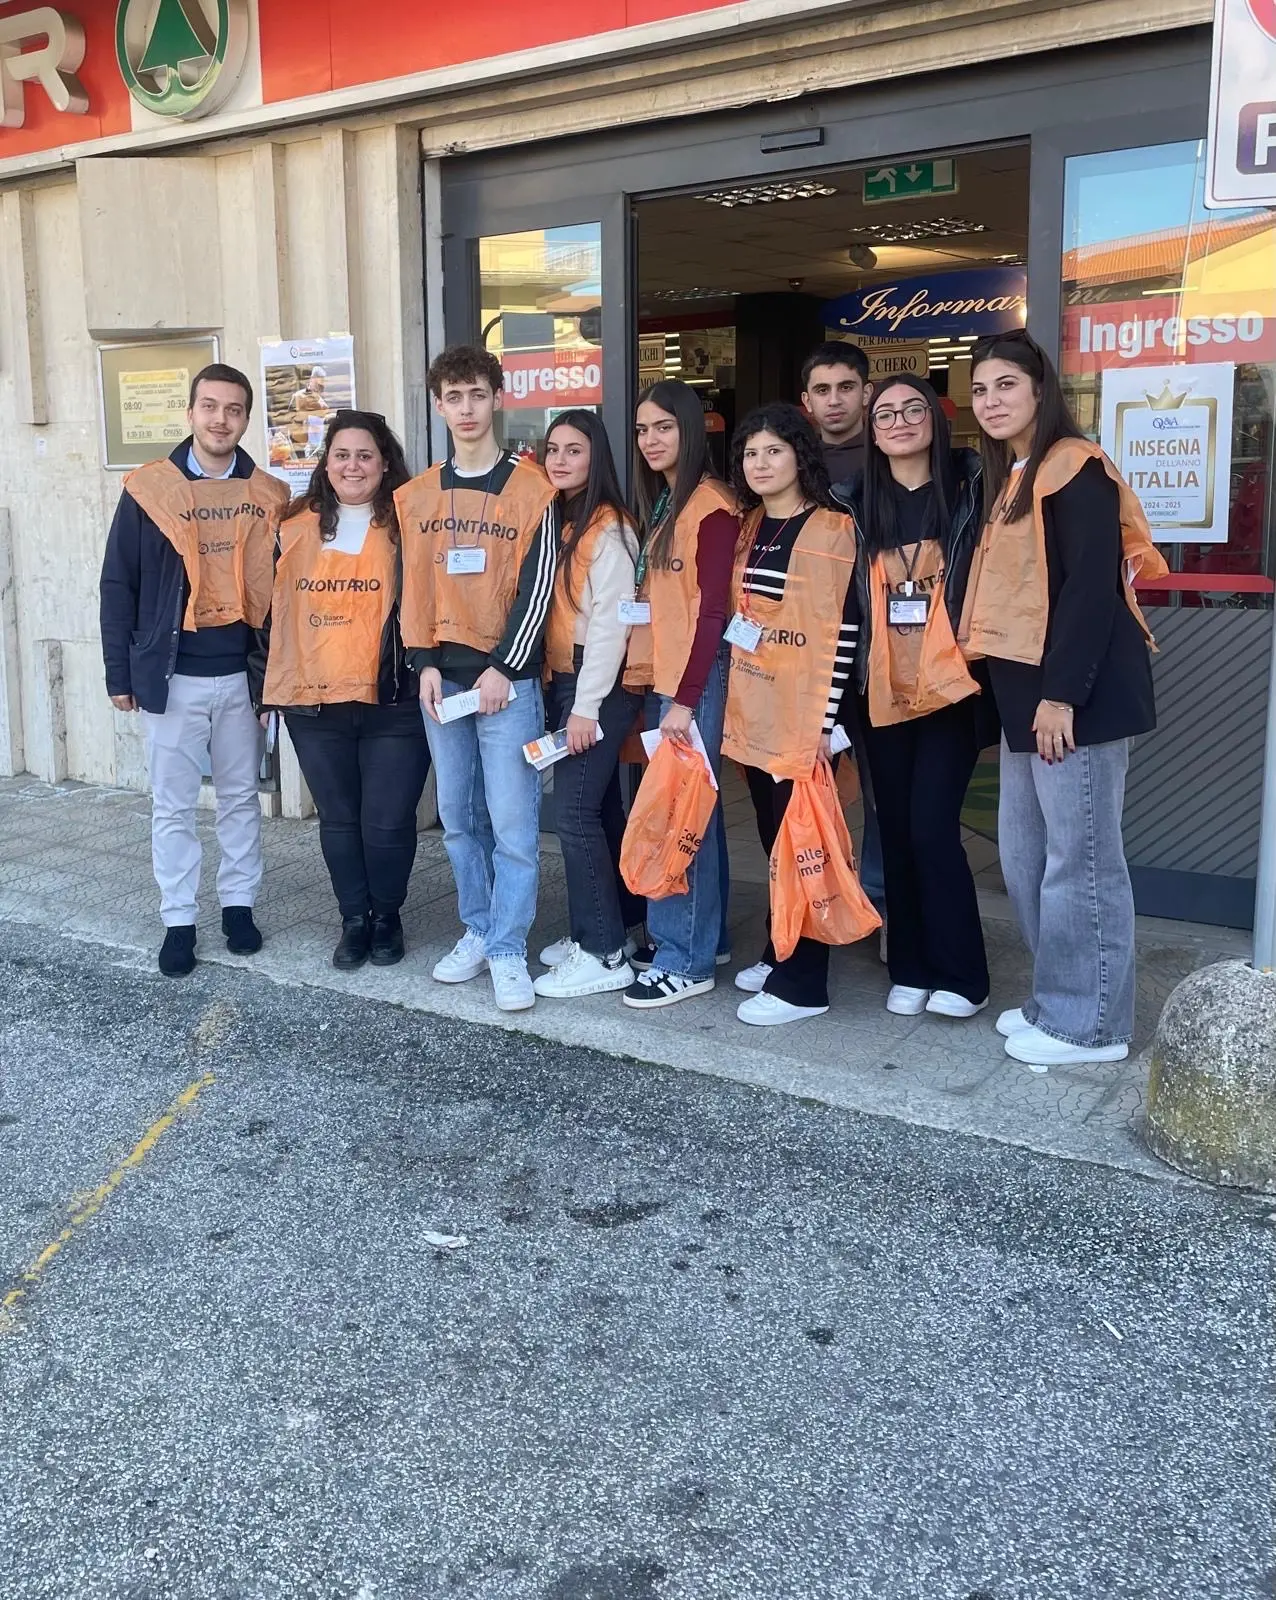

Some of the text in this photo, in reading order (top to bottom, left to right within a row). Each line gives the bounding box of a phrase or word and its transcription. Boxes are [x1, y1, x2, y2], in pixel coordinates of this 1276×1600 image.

[1079, 311, 1264, 358] Ingresso
[870, 356, 917, 374] CCHERO
[502, 364, 601, 399] ngresso
[123, 401, 142, 411] 08:00
[1152, 417, 1179, 430] Q&A
[1129, 438, 1200, 457] INSEGNA
[1155, 459, 1200, 468] DELL'ANNO
[1128, 470, 1199, 489] ITALIA
[1143, 501, 1160, 509] 2024
[1165, 501, 1181, 509] 2025
[295, 577, 381, 592] VOLONTARIO
[565, 977, 631, 996] RICHMOND
